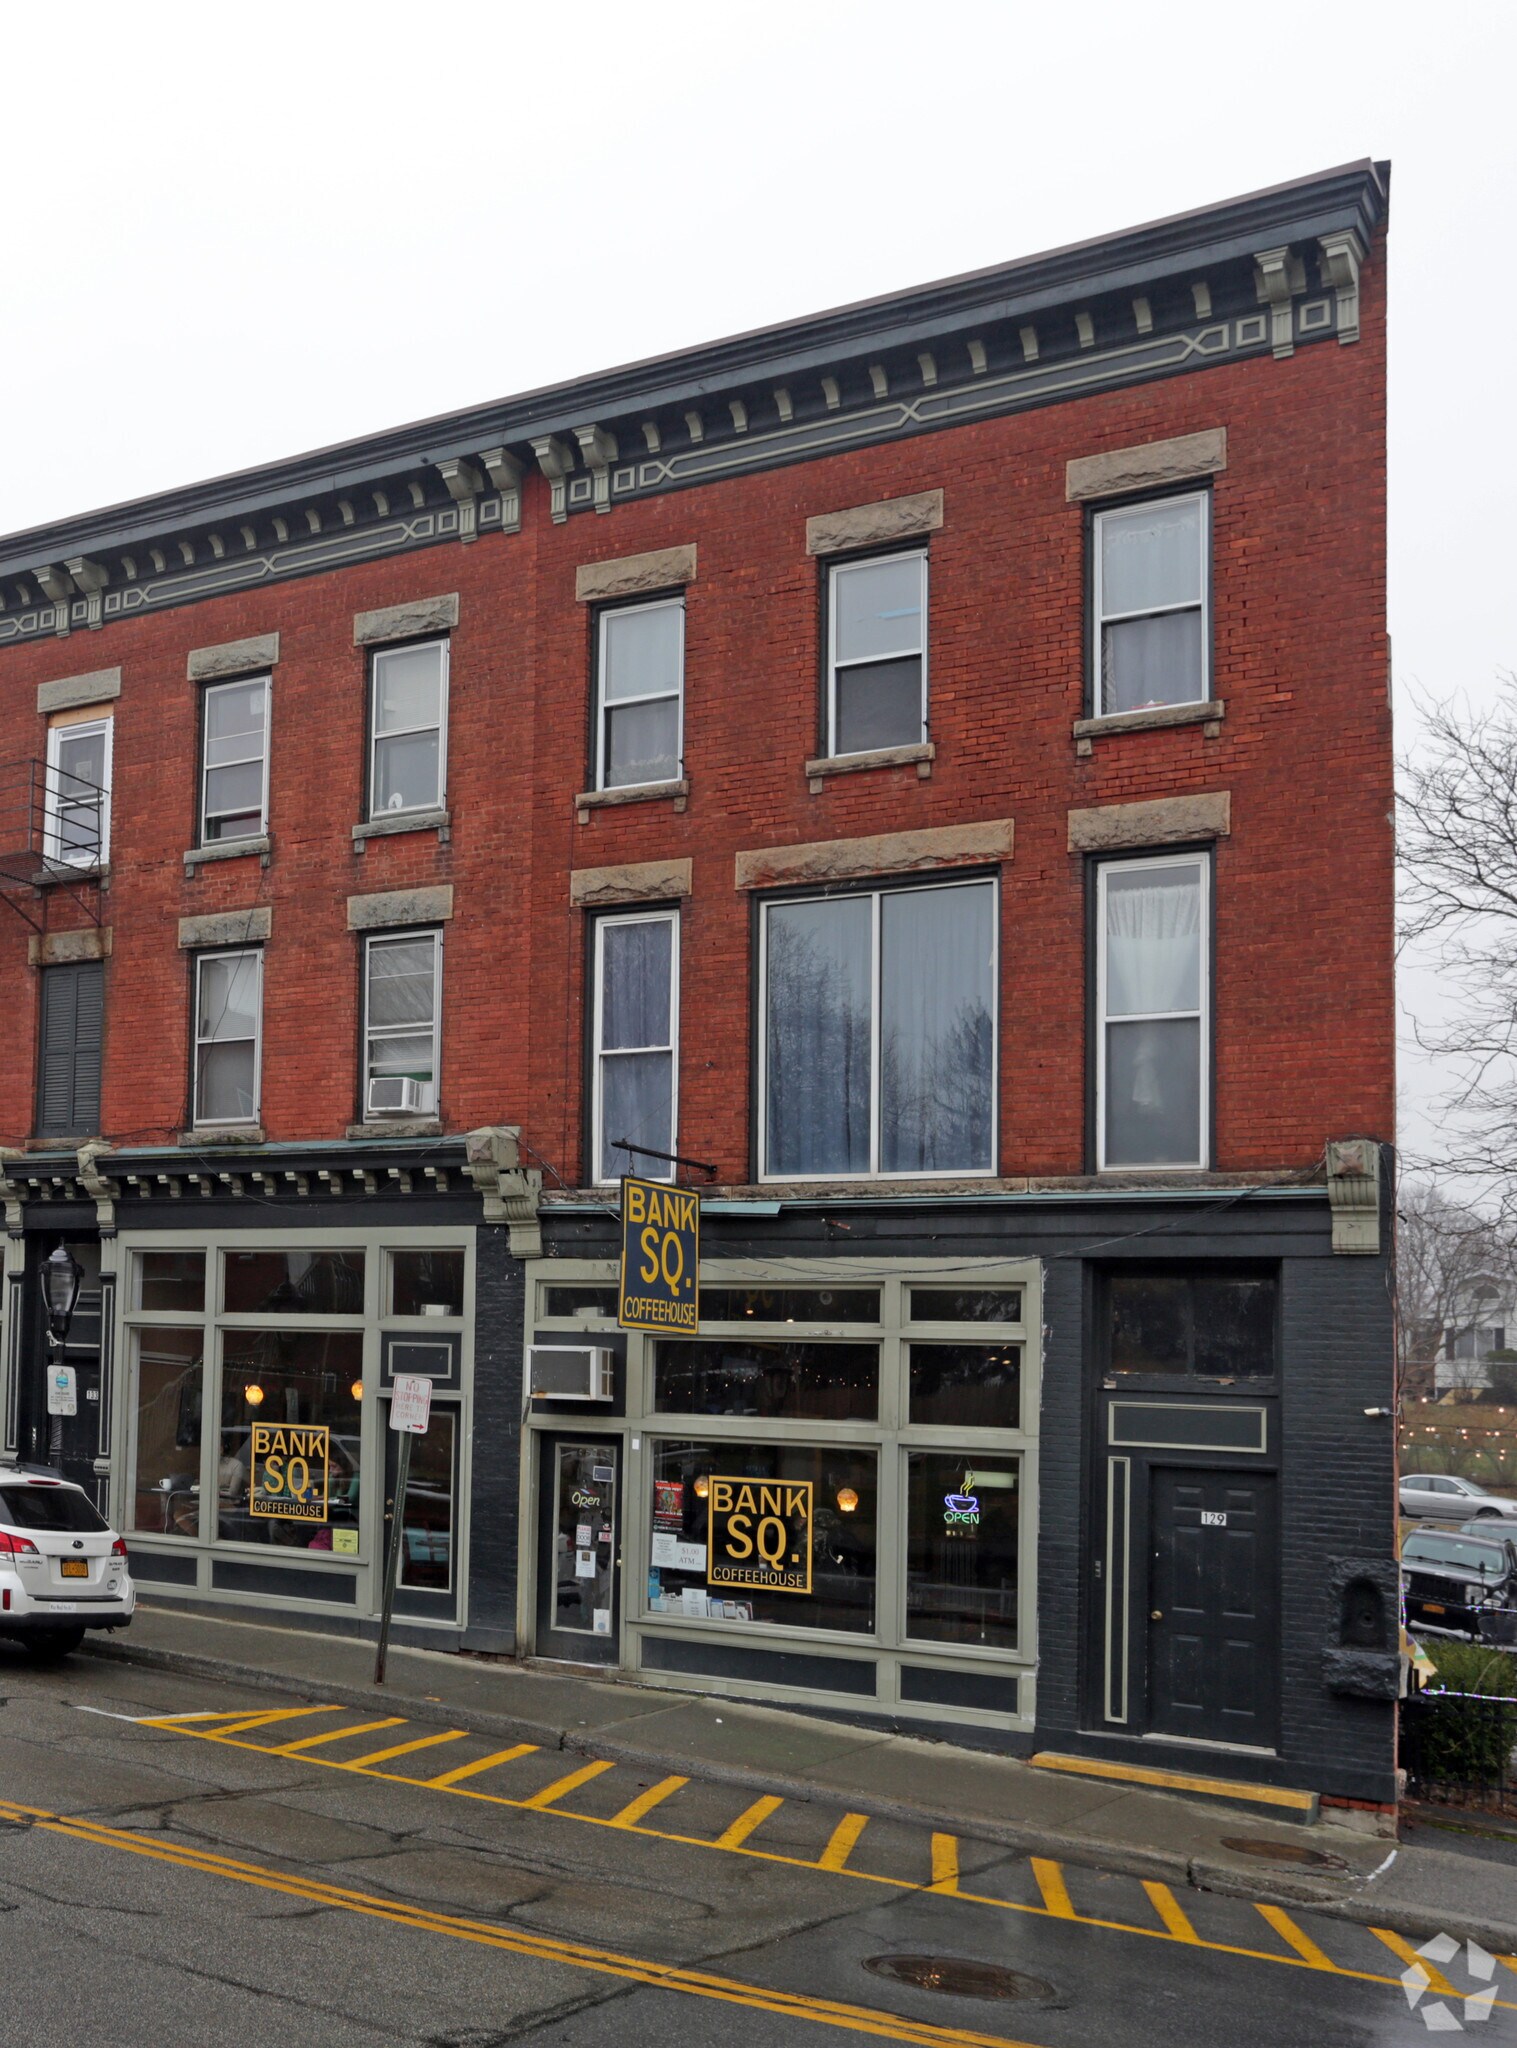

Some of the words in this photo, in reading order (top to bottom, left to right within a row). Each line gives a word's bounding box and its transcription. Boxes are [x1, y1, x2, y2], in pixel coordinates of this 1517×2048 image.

[628, 1186, 696, 1233] BANK
[640, 1226, 692, 1297] SQ.
[624, 1296, 696, 1326] COFFEEHOUSE
[406, 1381, 420, 1392] NO
[255, 1429, 325, 1458] BANK
[263, 1455, 319, 1504] SQ.
[254, 1500, 322, 1518] COFFEEHOUSE
[571, 1491, 601, 1508] Open
[713, 1483, 808, 1519] BANK
[943, 1511, 980, 1524] OPEN
[1204, 1512, 1225, 1525] 129
[725, 1514, 800, 1572] SQ.
[679, 1556, 695, 1565] ATM
[713, 1566, 804, 1588] COFFEEHOUSE
